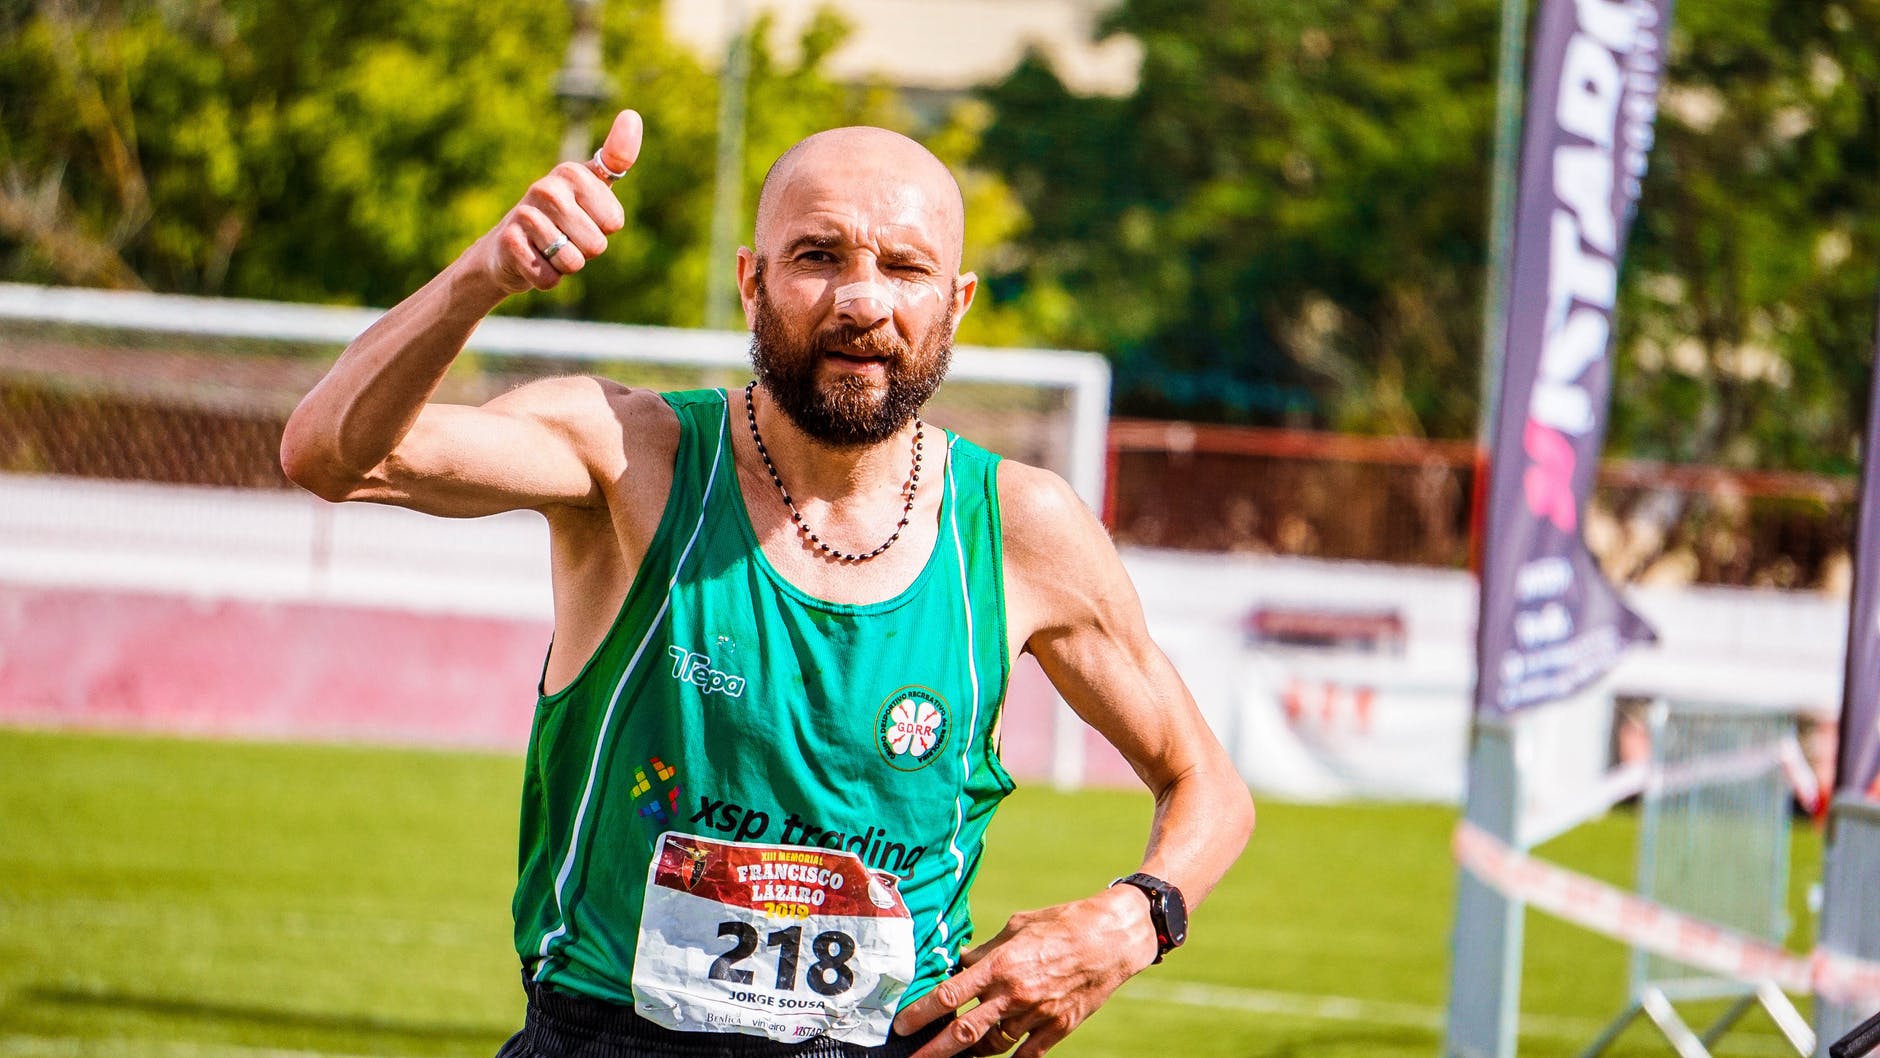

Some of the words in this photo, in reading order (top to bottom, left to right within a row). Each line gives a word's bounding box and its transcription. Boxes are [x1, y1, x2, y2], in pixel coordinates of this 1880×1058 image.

[880, 693, 907, 734] DESPORTIVO
[908, 690, 946, 716] RECREATIVO
[689, 796, 770, 843] xsp
[780, 814, 928, 881] trading
[761, 851, 777, 862] XIII
[778, 852, 824, 866] MEMORIAL
[736, 863, 844, 890] FRANCISCO
[751, 880, 826, 906] LÁZARO
[764, 902, 810, 921] 2019
[708, 921, 856, 996] 218
[728, 991, 775, 1007] JORGE
[778, 998, 826, 1010] SOUSA
